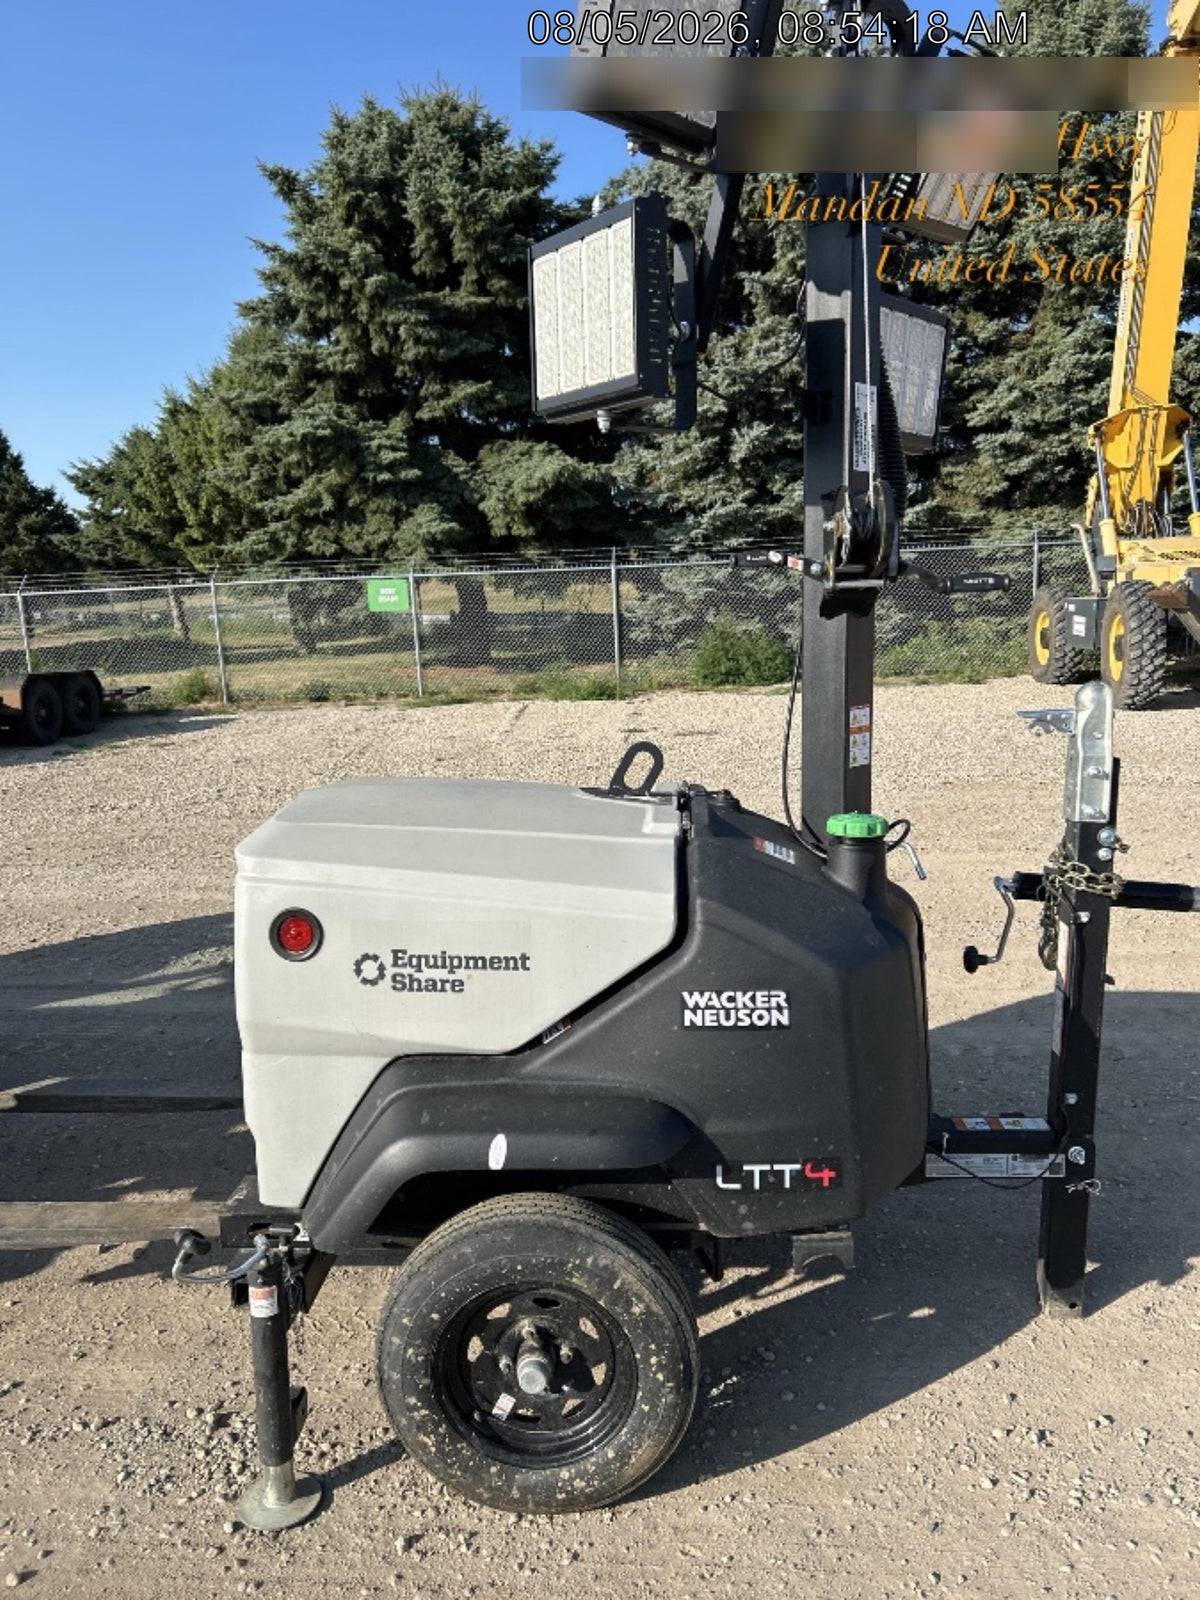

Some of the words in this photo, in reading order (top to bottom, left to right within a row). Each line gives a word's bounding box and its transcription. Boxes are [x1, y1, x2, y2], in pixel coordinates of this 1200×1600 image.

[390, 948, 531, 974] Equipment
[390, 972, 465, 993] Share
[681, 990, 789, 1009] WACKER
[683, 1008, 790, 1027] NEUSON
[715, 1161, 837, 1190] LTT4
